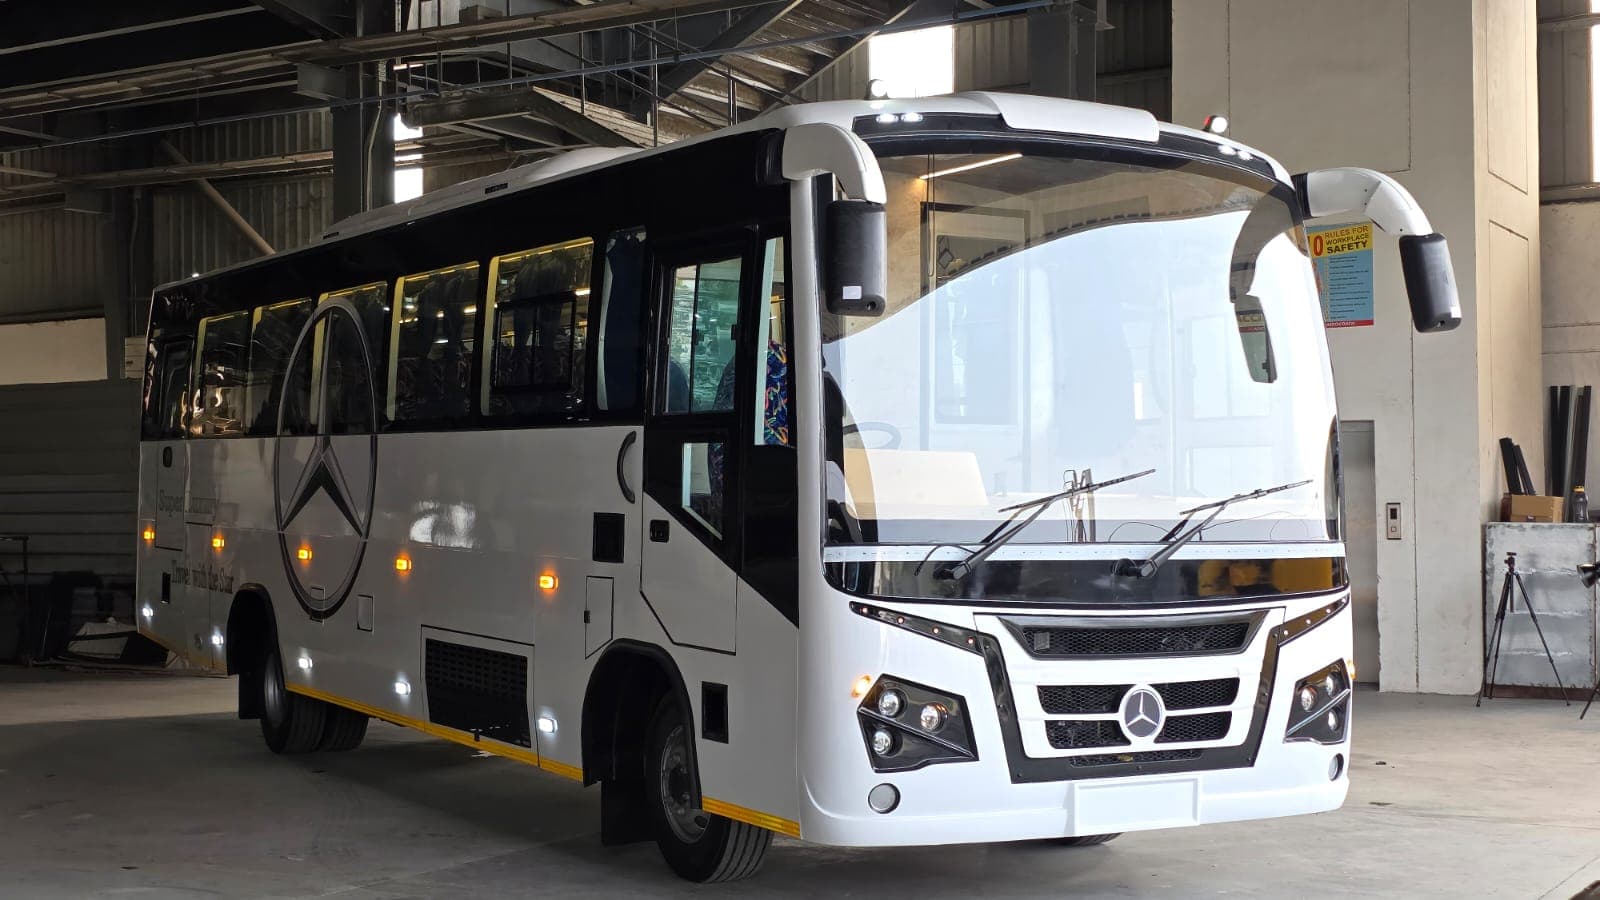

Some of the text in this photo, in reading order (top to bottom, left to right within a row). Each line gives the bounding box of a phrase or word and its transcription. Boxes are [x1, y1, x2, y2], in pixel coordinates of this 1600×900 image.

[1324, 225, 1369, 239] RULES FOR
[1326, 232, 1369, 246] WORKPLACE
[1326, 240, 1368, 254] SAFETY
